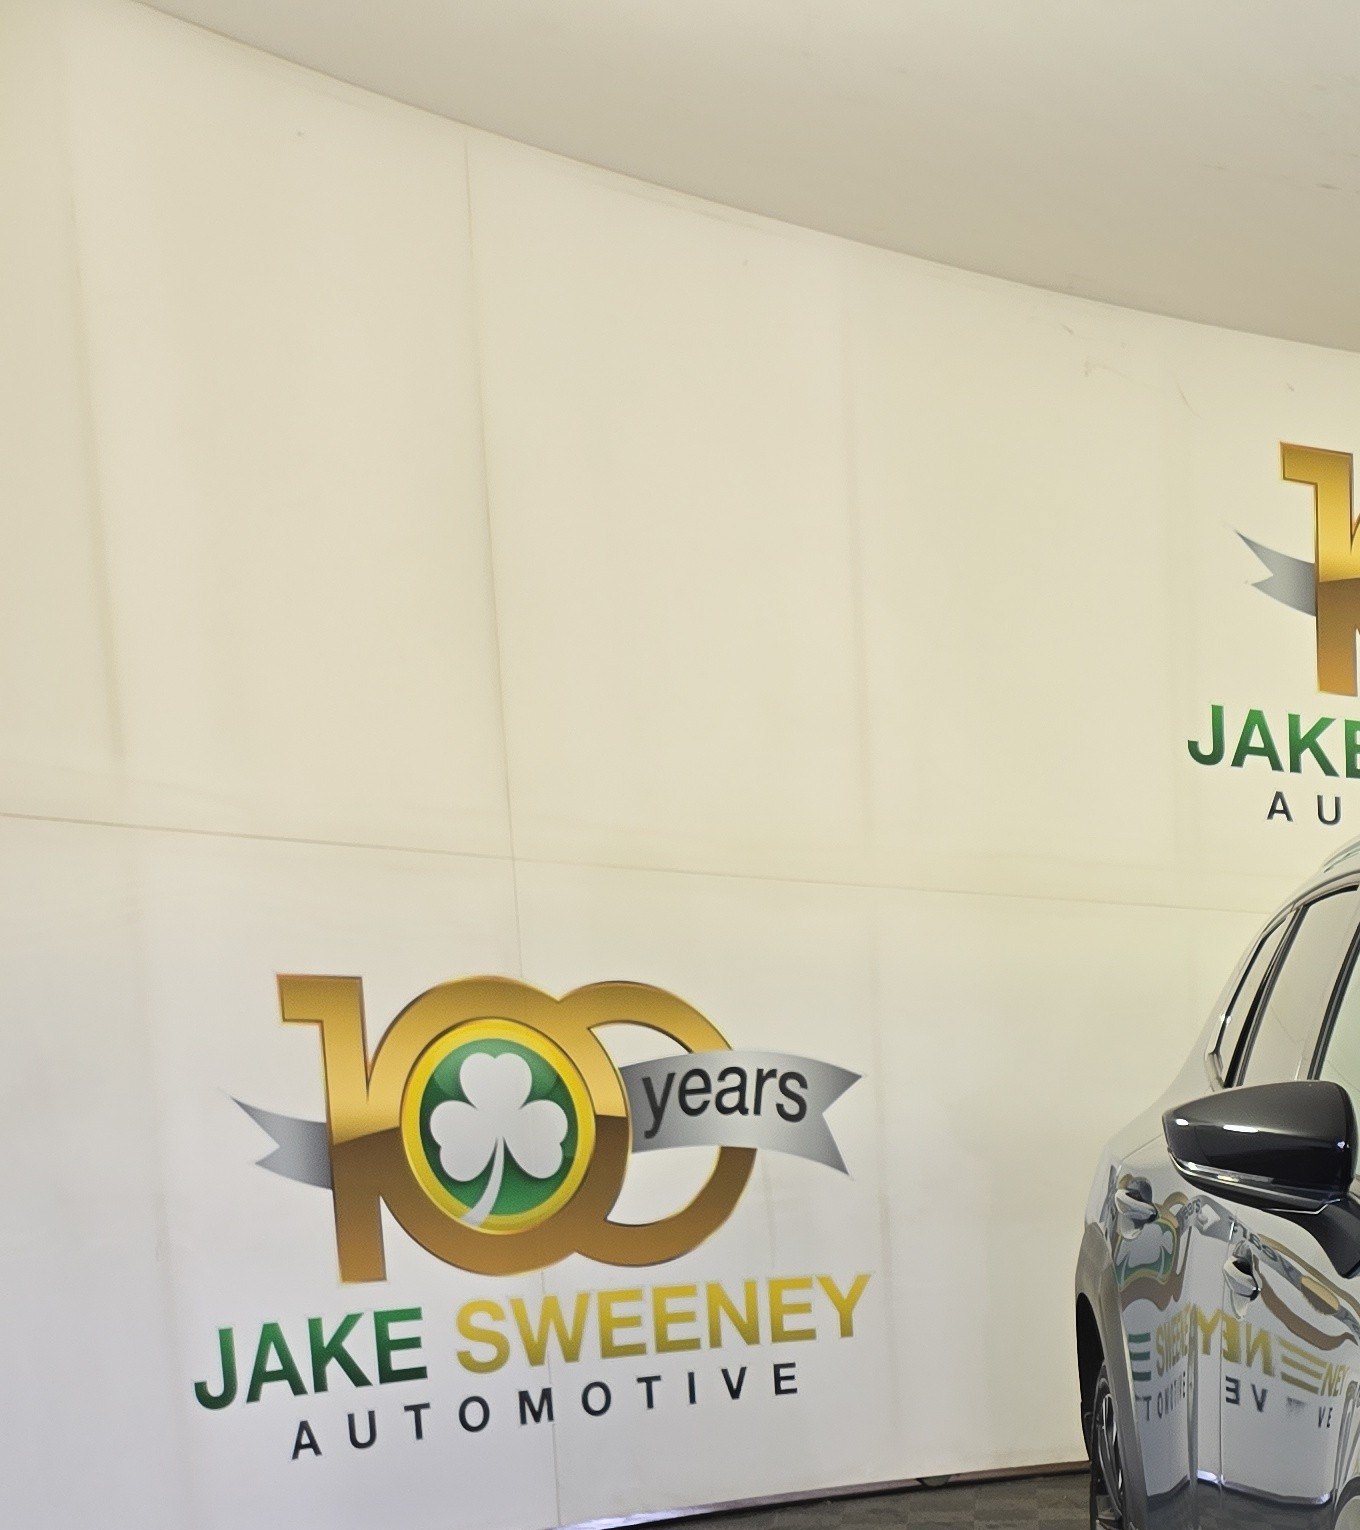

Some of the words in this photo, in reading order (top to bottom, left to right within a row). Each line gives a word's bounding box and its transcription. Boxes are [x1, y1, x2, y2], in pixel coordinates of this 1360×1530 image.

[642, 1065, 809, 1139] years
[194, 1307, 428, 1411] JAKE
[456, 1274, 871, 1374] SWEENEY
[291, 1362, 798, 1460] AUTOMOTIVE
